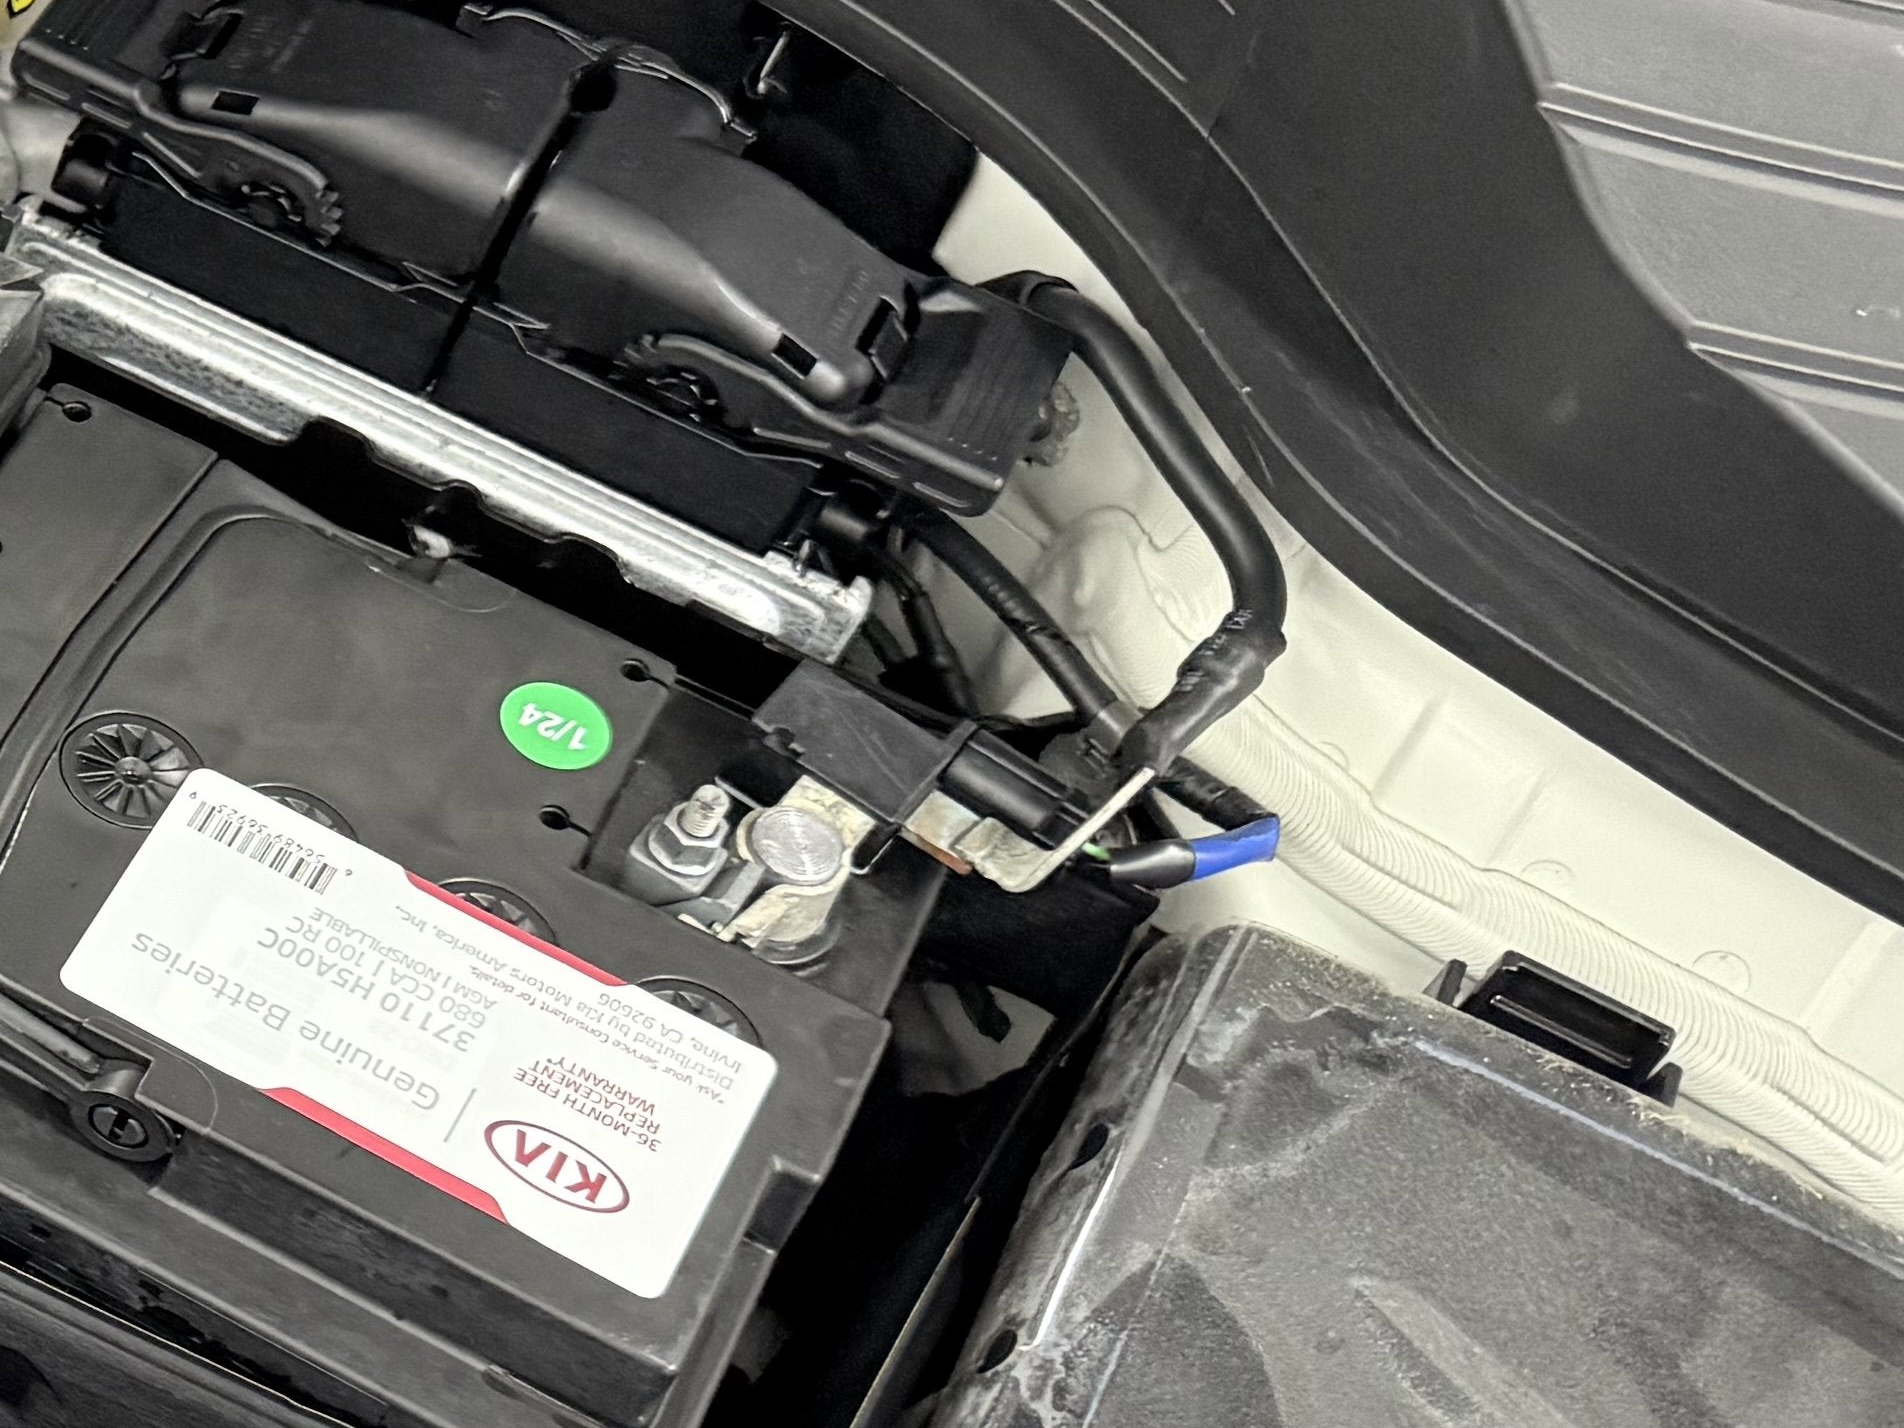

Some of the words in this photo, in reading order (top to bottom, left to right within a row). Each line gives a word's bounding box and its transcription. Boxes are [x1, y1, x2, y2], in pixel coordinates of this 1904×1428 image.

[518, 702, 587, 750] 1/24
[284, 913, 322, 944] RC
[307, 904, 442, 986] NONSPILLABLE
[427, 922, 508, 975] America,
[255, 924, 375, 1001] H5A00C
[321, 932, 368, 969] 100
[126, 929, 291, 1032] Batteries
[384, 965, 435, 1004] CCA
[448, 979, 497, 1016] AGM
[507, 964, 573, 1008] Motors
[516, 989, 537, 1007] for
[376, 989, 475, 1053] 37110
[435, 993, 488, 1032] 680
[537, 999, 610, 1045] Consultant
[573, 999, 604, 1025] Kia
[595, 990, 656, 1031] 92606
[605, 1014, 632, 1038] by
[609, 1037, 660, 1070] Service
[655, 1021, 684, 1045] CA
[292, 1017, 443, 1113] Genuine
[631, 1028, 734, 1091] Distributed
[660, 1062, 694, 1087] your
[685, 1035, 743, 1074] Irvine,
[511, 1065, 561, 1100] FREE
[527, 1056, 661, 1136] REPLACEMENT
[561, 1091, 662, 1153] 36-MONTH
[502, 1127, 609, 1204] KIA
